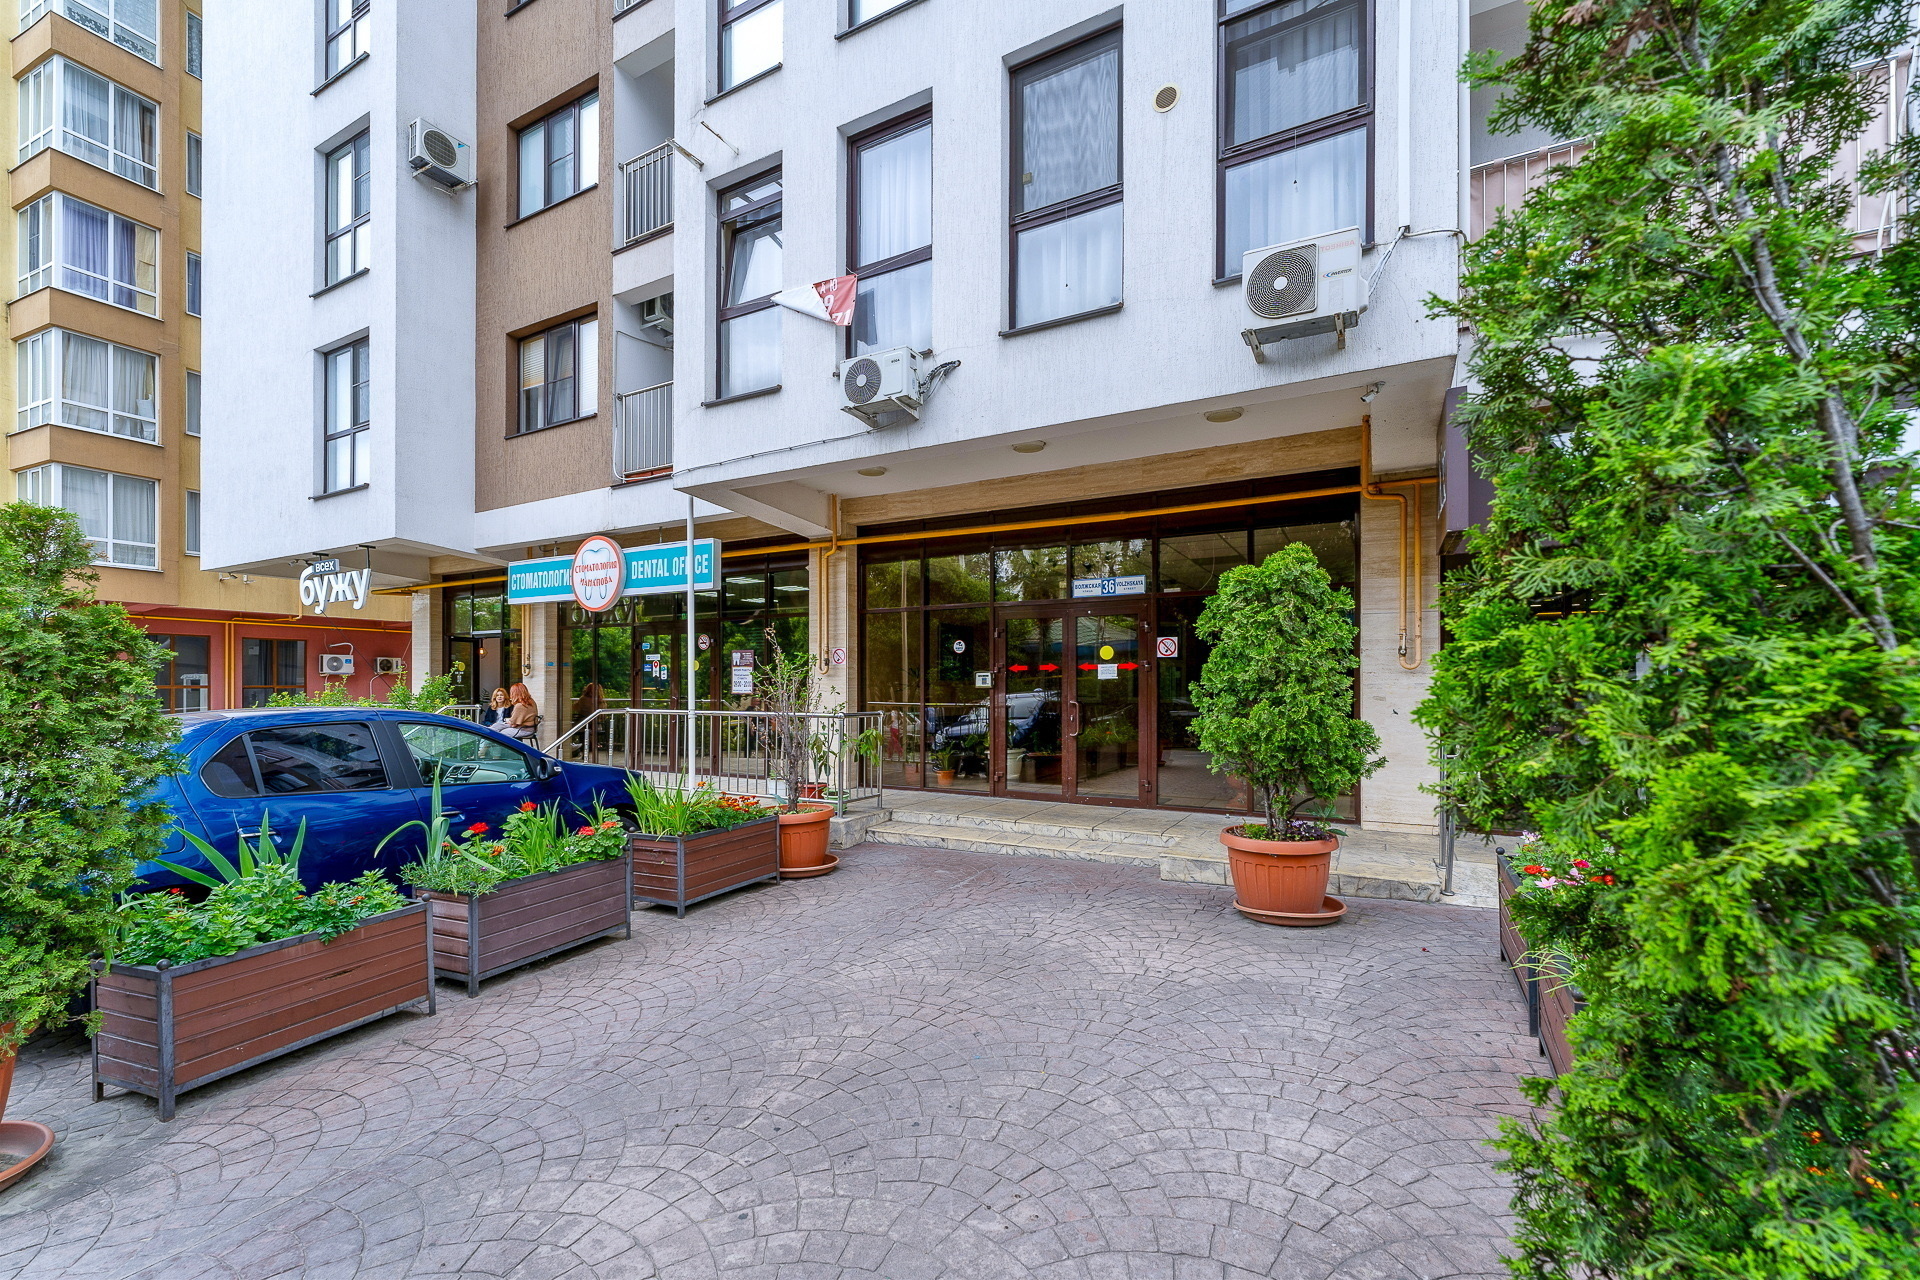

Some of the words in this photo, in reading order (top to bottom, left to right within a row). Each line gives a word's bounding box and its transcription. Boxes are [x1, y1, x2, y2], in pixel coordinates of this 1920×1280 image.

[1320, 240, 1355, 251] TOSHIBA
[315, 560, 335, 573] всех
[575, 560, 618, 574] СТОМАТОЛОГИЯ
[632, 558, 669, 579] DENTAL
[672, 553, 709, 577] OFCE
[300, 566, 371, 615] бужу
[1102, 579, 1115, 593] 36
